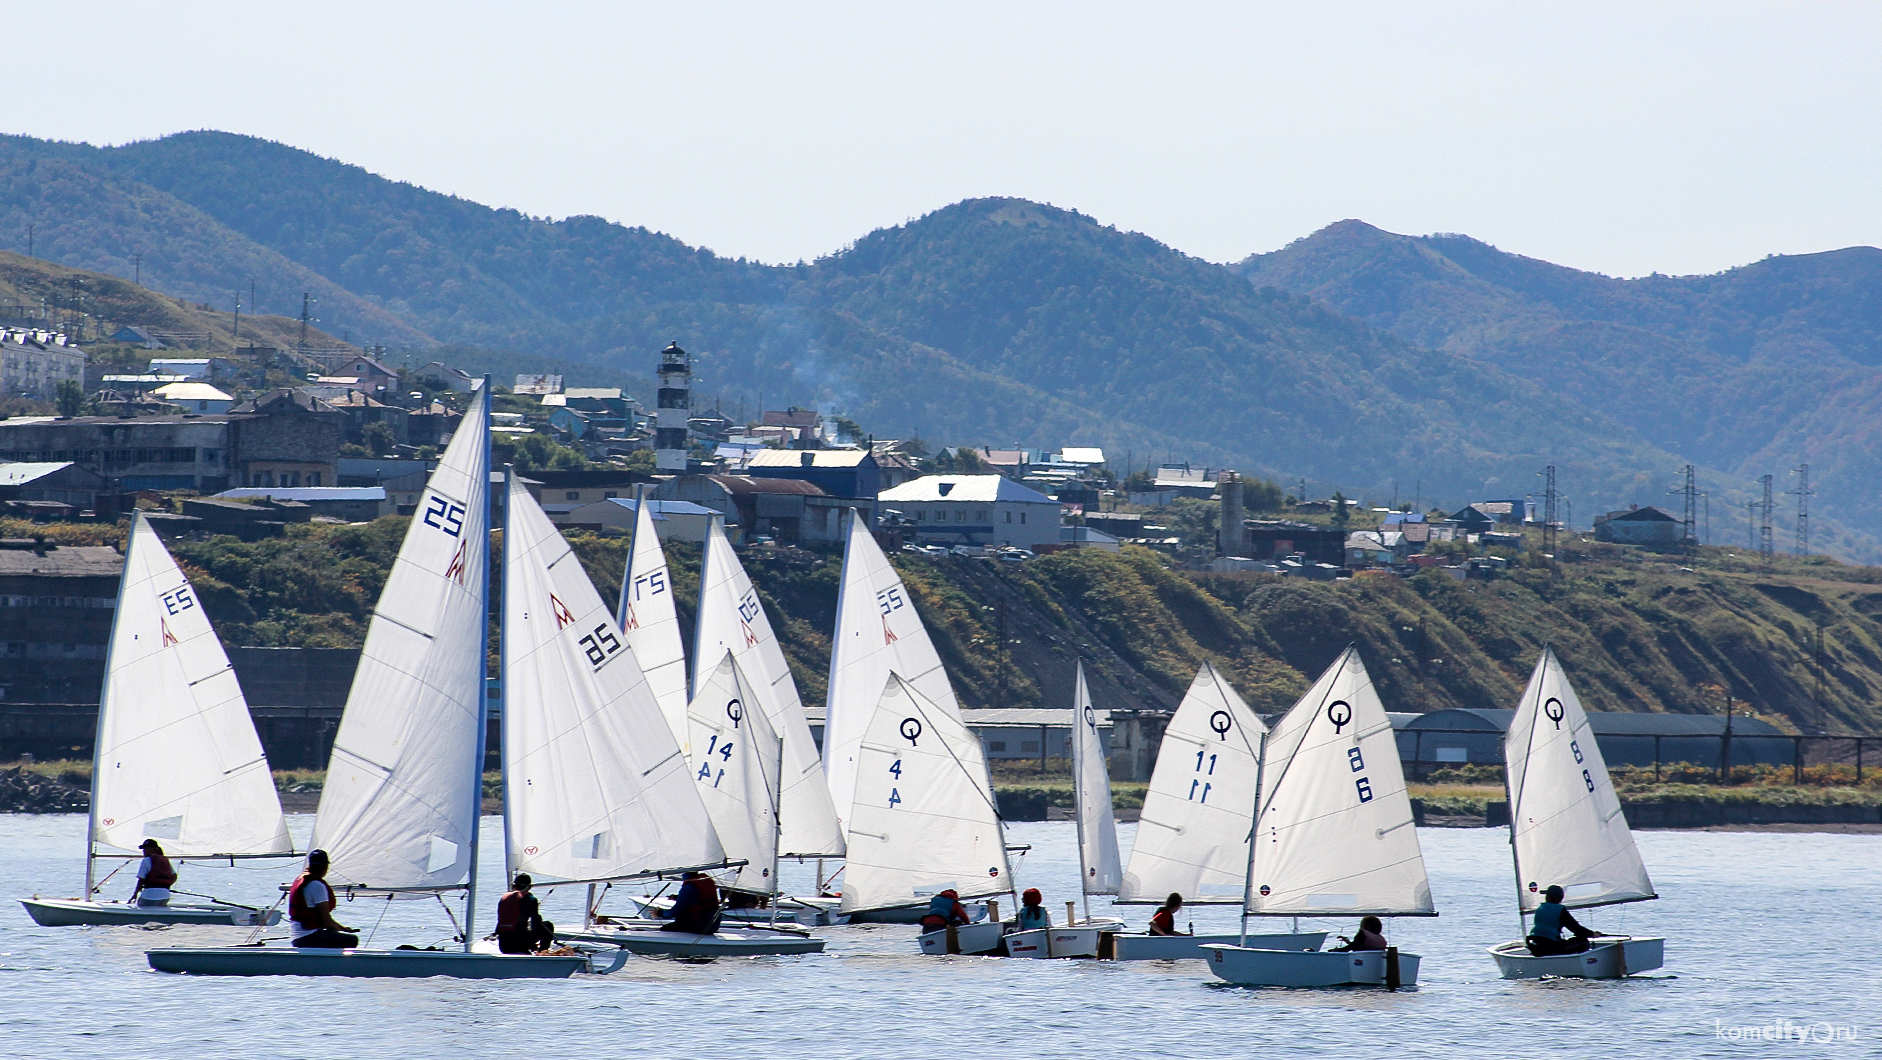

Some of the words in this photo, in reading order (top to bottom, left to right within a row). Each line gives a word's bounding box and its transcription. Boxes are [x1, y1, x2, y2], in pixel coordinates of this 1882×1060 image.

[707, 735, 734, 762] 14
[1570, 740, 1584, 765] 8
[889, 759, 902, 780] 4
[1195, 751, 1218, 775] 11
[1356, 777, 1373, 803] 6
[1582, 769, 1595, 793] 8
